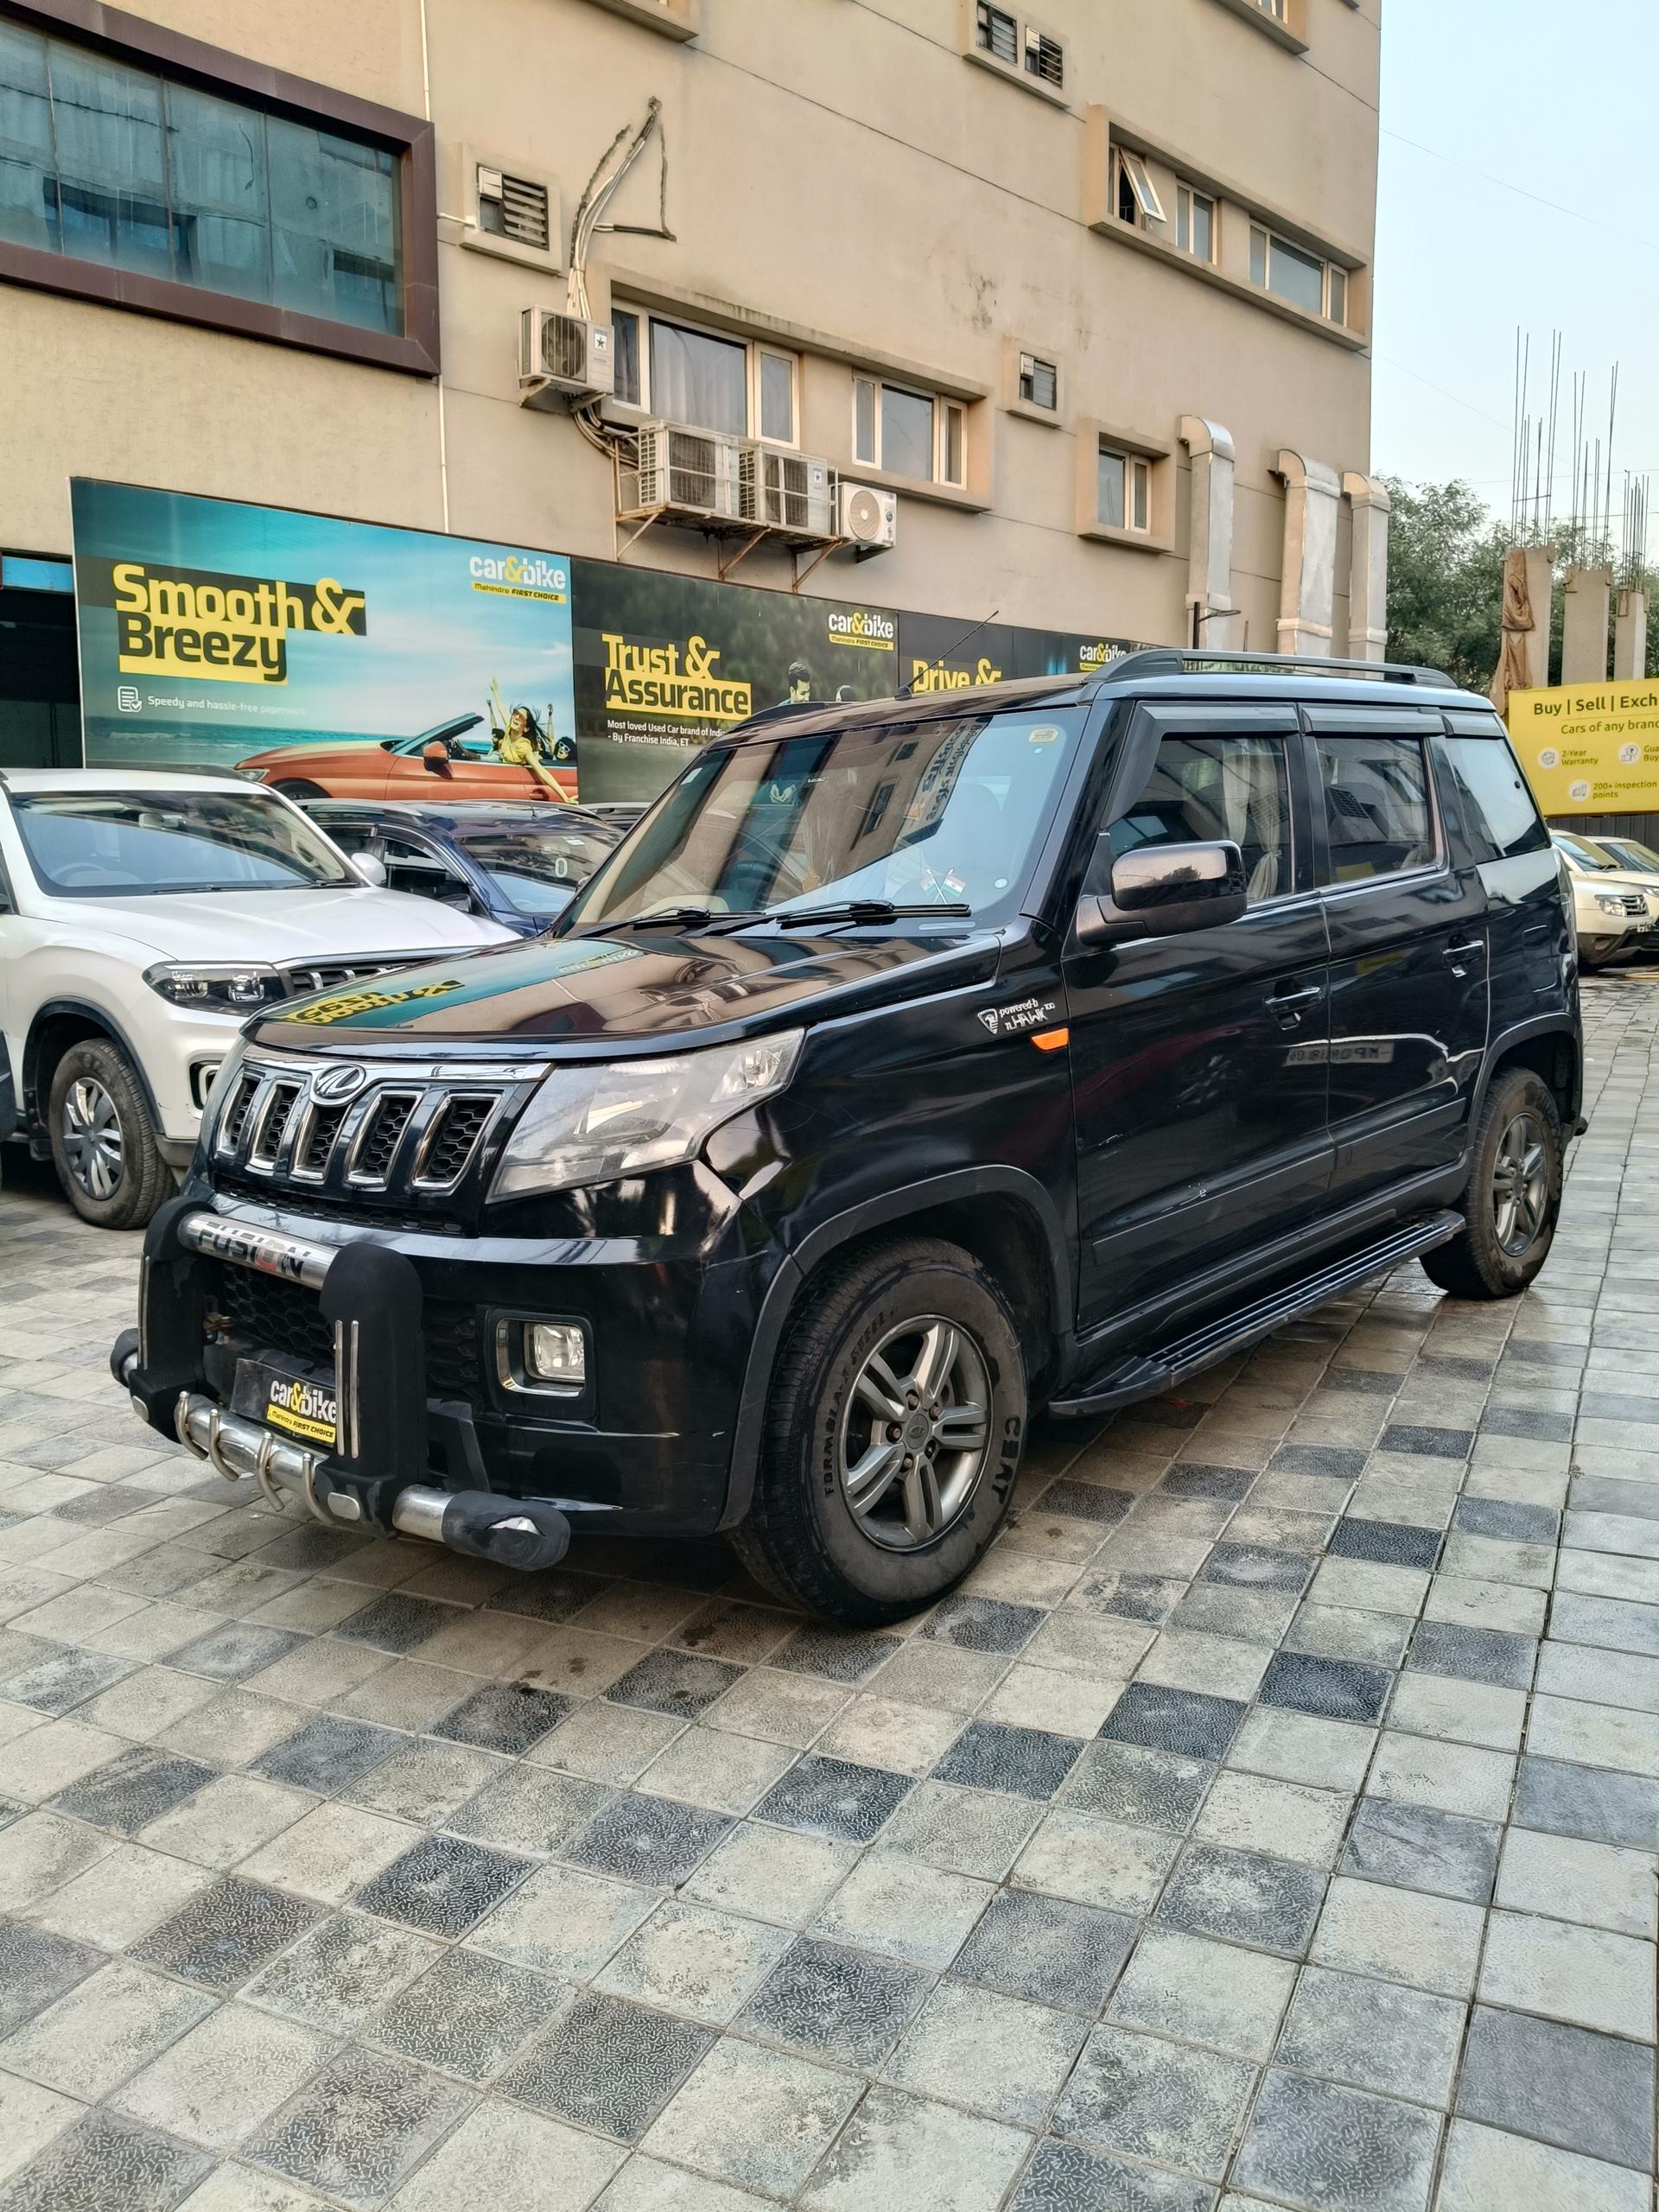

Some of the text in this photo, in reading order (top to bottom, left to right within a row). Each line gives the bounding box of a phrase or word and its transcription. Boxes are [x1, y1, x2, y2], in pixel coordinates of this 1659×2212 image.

[470, 556, 566, 590] car&bike
[111, 563, 365, 635] Smooth &
[474, 583, 559, 601] Mahindra FIRST CHOICE
[829, 612, 893, 639] car&bike
[118, 611, 287, 682] Breezy
[601, 633, 721, 680] Trust &
[912, 657, 1002, 693] Drive &
[606, 669, 749, 715] Assurance
[148, 696, 185, 709] Speedy
[186, 698, 205, 709] and
[207, 699, 258, 714] hassle-free
[1534, 702, 1562, 716] Buy
[1576, 696, 1606, 712] Sell
[1620, 693, 1659, 709] Exch
[607, 719, 626, 729] Most
[627, 721, 647, 732] loved
[648, 722, 666, 733] Used
[667, 723, 679, 734] Car
[680, 725, 701, 736] brand
[702, 726, 709, 736] of
[1561, 724, 1586, 734] Cars
[1589, 721, 1601, 732] of
[1605, 721, 1624, 733] any
[613, 732, 623, 744] By
[624, 734, 658, 745] Franchise
[660, 737, 679, 747] India,
[680, 738, 690, 747] ET
[1561, 757, 1599, 766] Warranty
[1592, 781, 1657, 791] 200+ inspection
[1592, 791, 1618, 800] points
[270, 1380, 337, 1424] car&bike
[293, 1421, 310, 1431] FIRST
[310, 1426, 334, 1438] CHOICE
[991, 1415, 1021, 1505] CEAT
